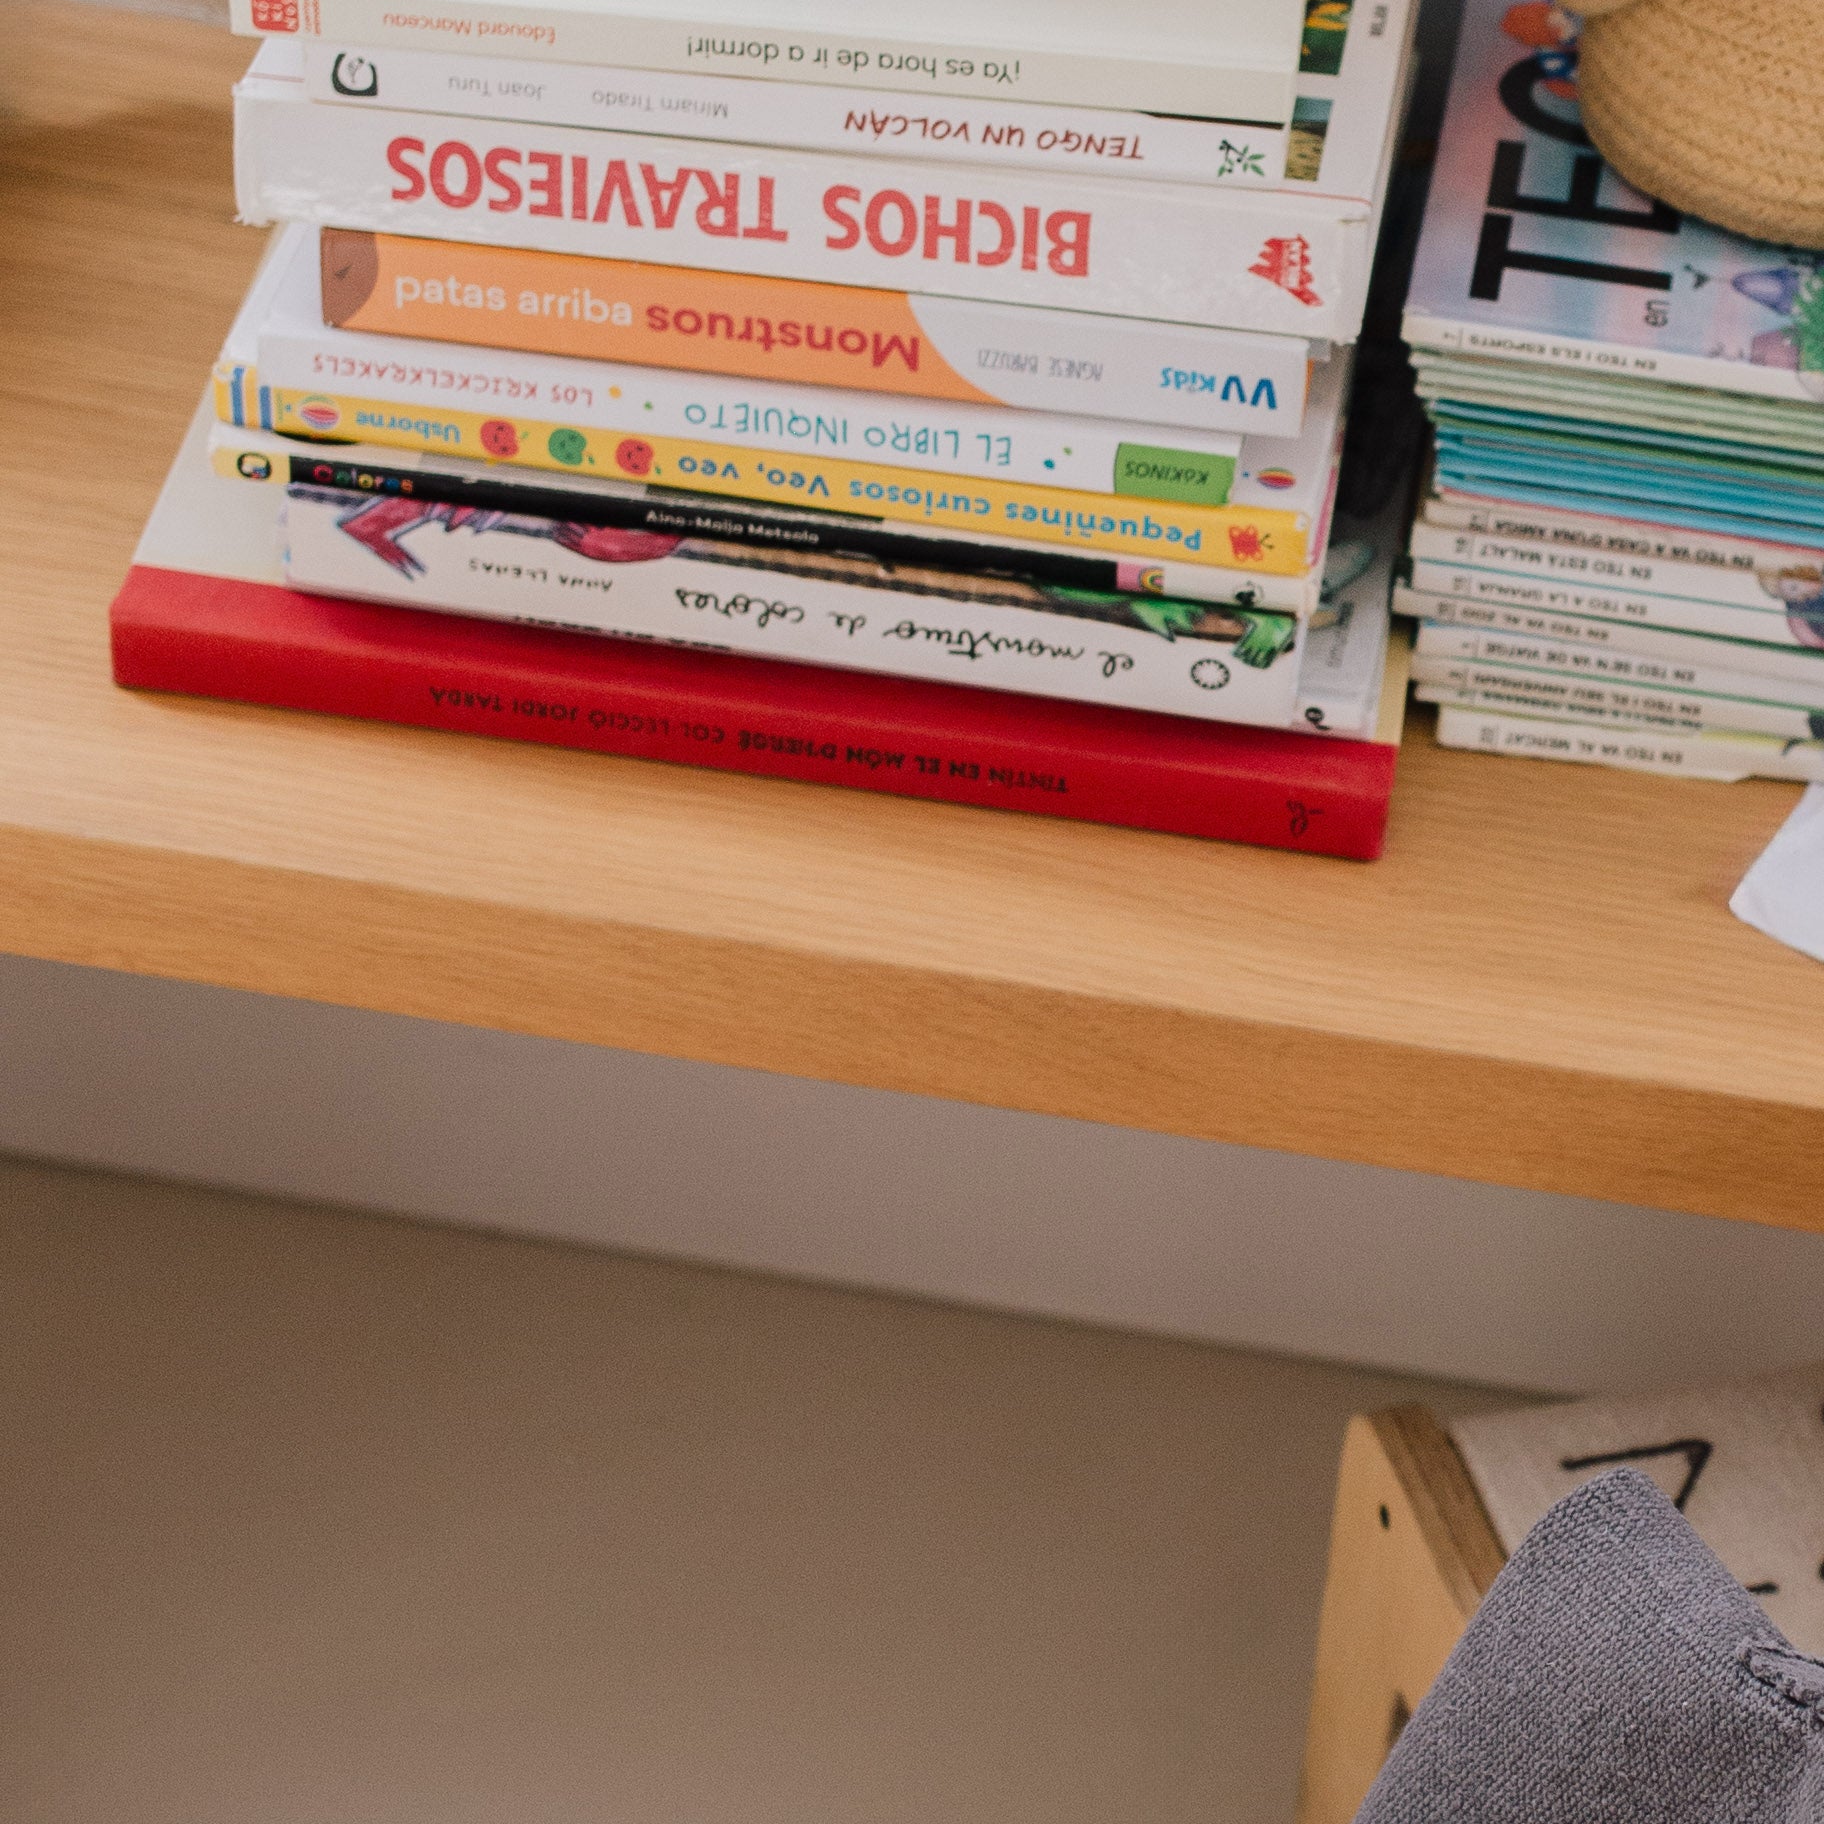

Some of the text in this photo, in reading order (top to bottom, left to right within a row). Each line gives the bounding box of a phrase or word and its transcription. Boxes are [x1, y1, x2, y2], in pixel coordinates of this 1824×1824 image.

[383, 13, 472, 36] Manceau
[687, 36, 781, 64] dormir!
[788, 44, 806, 63] a
[813, 46, 829, 69] ir
[836, 47, 870, 72] de
[879, 52, 937, 79] hora
[946, 58, 976, 76] es
[448, 75, 547, 101] Joan Turu
[591, 90, 729, 119] Miriam Tirado
[844, 109, 1145, 160] TENGO UN VOLCÁN
[386, 136, 1093, 278] BICHOS TRAVIESOS
[393, 274, 633, 326] patas arriba
[646, 304, 921, 373] Monstruos
[551, 384, 594, 409] LOS
[356, 410, 462, 445] Usborne
[684, 402, 1012, 466] EL LIBRO INQUIETO
[678, 456, 1202, 552] Pequeñines curiosos Veo, veo
[676, 587, 1135, 678] el monstruo de colores
[512, 698, 579, 722] JORDI
[914, 755, 941, 775] EL
[949, 760, 980, 782] EN
